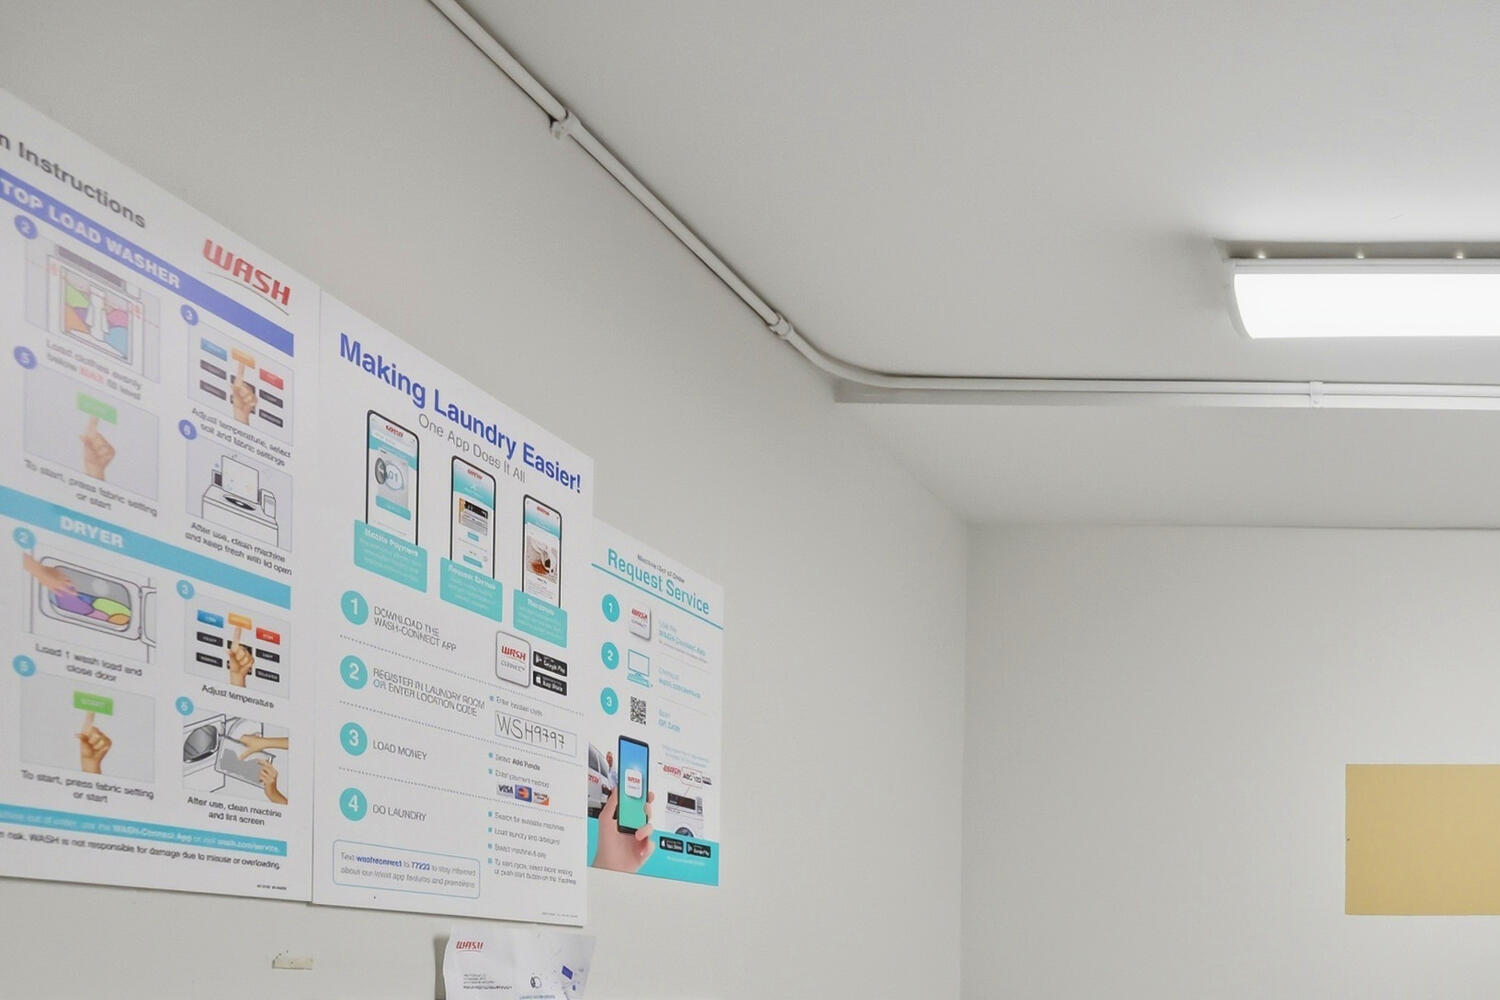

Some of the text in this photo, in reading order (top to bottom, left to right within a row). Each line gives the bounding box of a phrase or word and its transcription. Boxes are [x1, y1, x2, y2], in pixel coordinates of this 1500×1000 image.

[18, 141, 146, 229] Instructions
[1, 178, 181, 289] TOP LOAD WASHER
[202, 238, 291, 307] WASH
[338, 331, 582, 495] Making Laundry Easier!
[418, 412, 444, 438] One
[447, 429, 470, 453] App
[472, 443, 501, 469] Does
[502, 462, 511, 475] It
[512, 466, 526, 484] All
[59, 515, 125, 549] DRYER
[606, 547, 663, 593] Request
[665, 578, 711, 615] Service
[350, 597, 359, 616] 1
[373, 605, 440, 638] DOWNLOAD THE
[373, 616, 458, 652] WASH-CONNECT APP
[501, 645, 527, 661] WASH
[607, 649, 614, 661] 2
[348, 662, 360, 681] 2
[373, 667, 414, 690] REGISTER
[424, 683, 462, 702] LAUNDRY
[373, 679, 478, 717] OR ENTER LOCATION CODE
[348, 728, 360, 747] 3
[372, 739, 428, 761] LOAD MONEY
[498, 784, 514, 795] VISA
[228, 803, 249, 813] clean
[250, 807, 282, 818] machine
[347, 794, 359, 813] 4
[372, 803, 428, 823] DO LAUNDRY
[208, 811, 225, 820] and
[239, 817, 265, 826] screen
